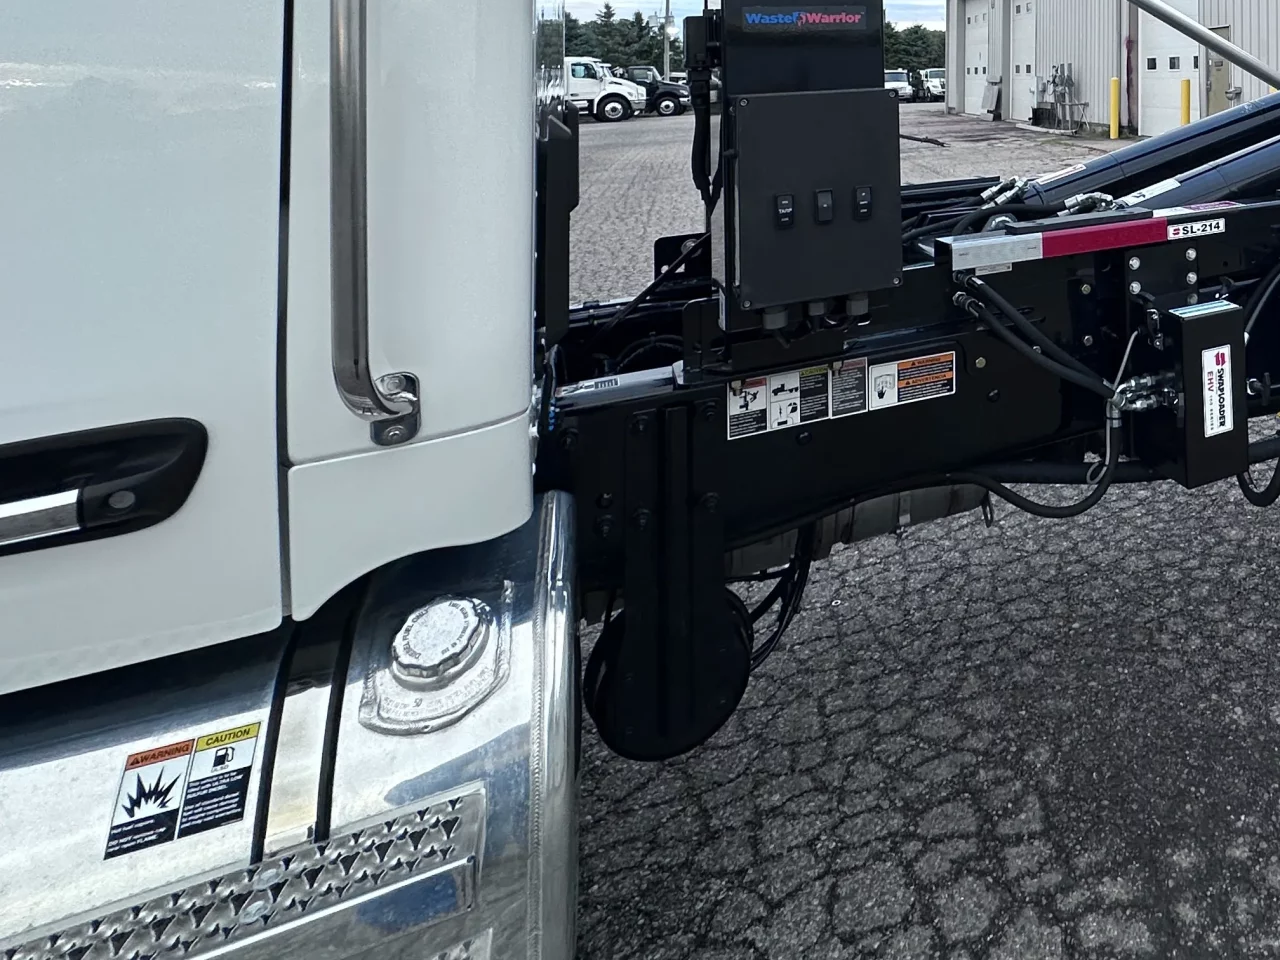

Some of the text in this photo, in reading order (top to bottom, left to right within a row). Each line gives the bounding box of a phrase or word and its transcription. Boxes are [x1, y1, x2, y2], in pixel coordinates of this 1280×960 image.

[807, 12, 862, 24] Warrior
[1182, 222, 1221, 235] SL-214
[912, 373, 947, 384] ADVERTENCIA
[1217, 368, 1226, 428] SWAPLOADER
[402, 605, 430, 659] DIESEL FUEL ONLY
[205, 728, 251, 746] CAUTION
[139, 745, 189, 762] WARNING
